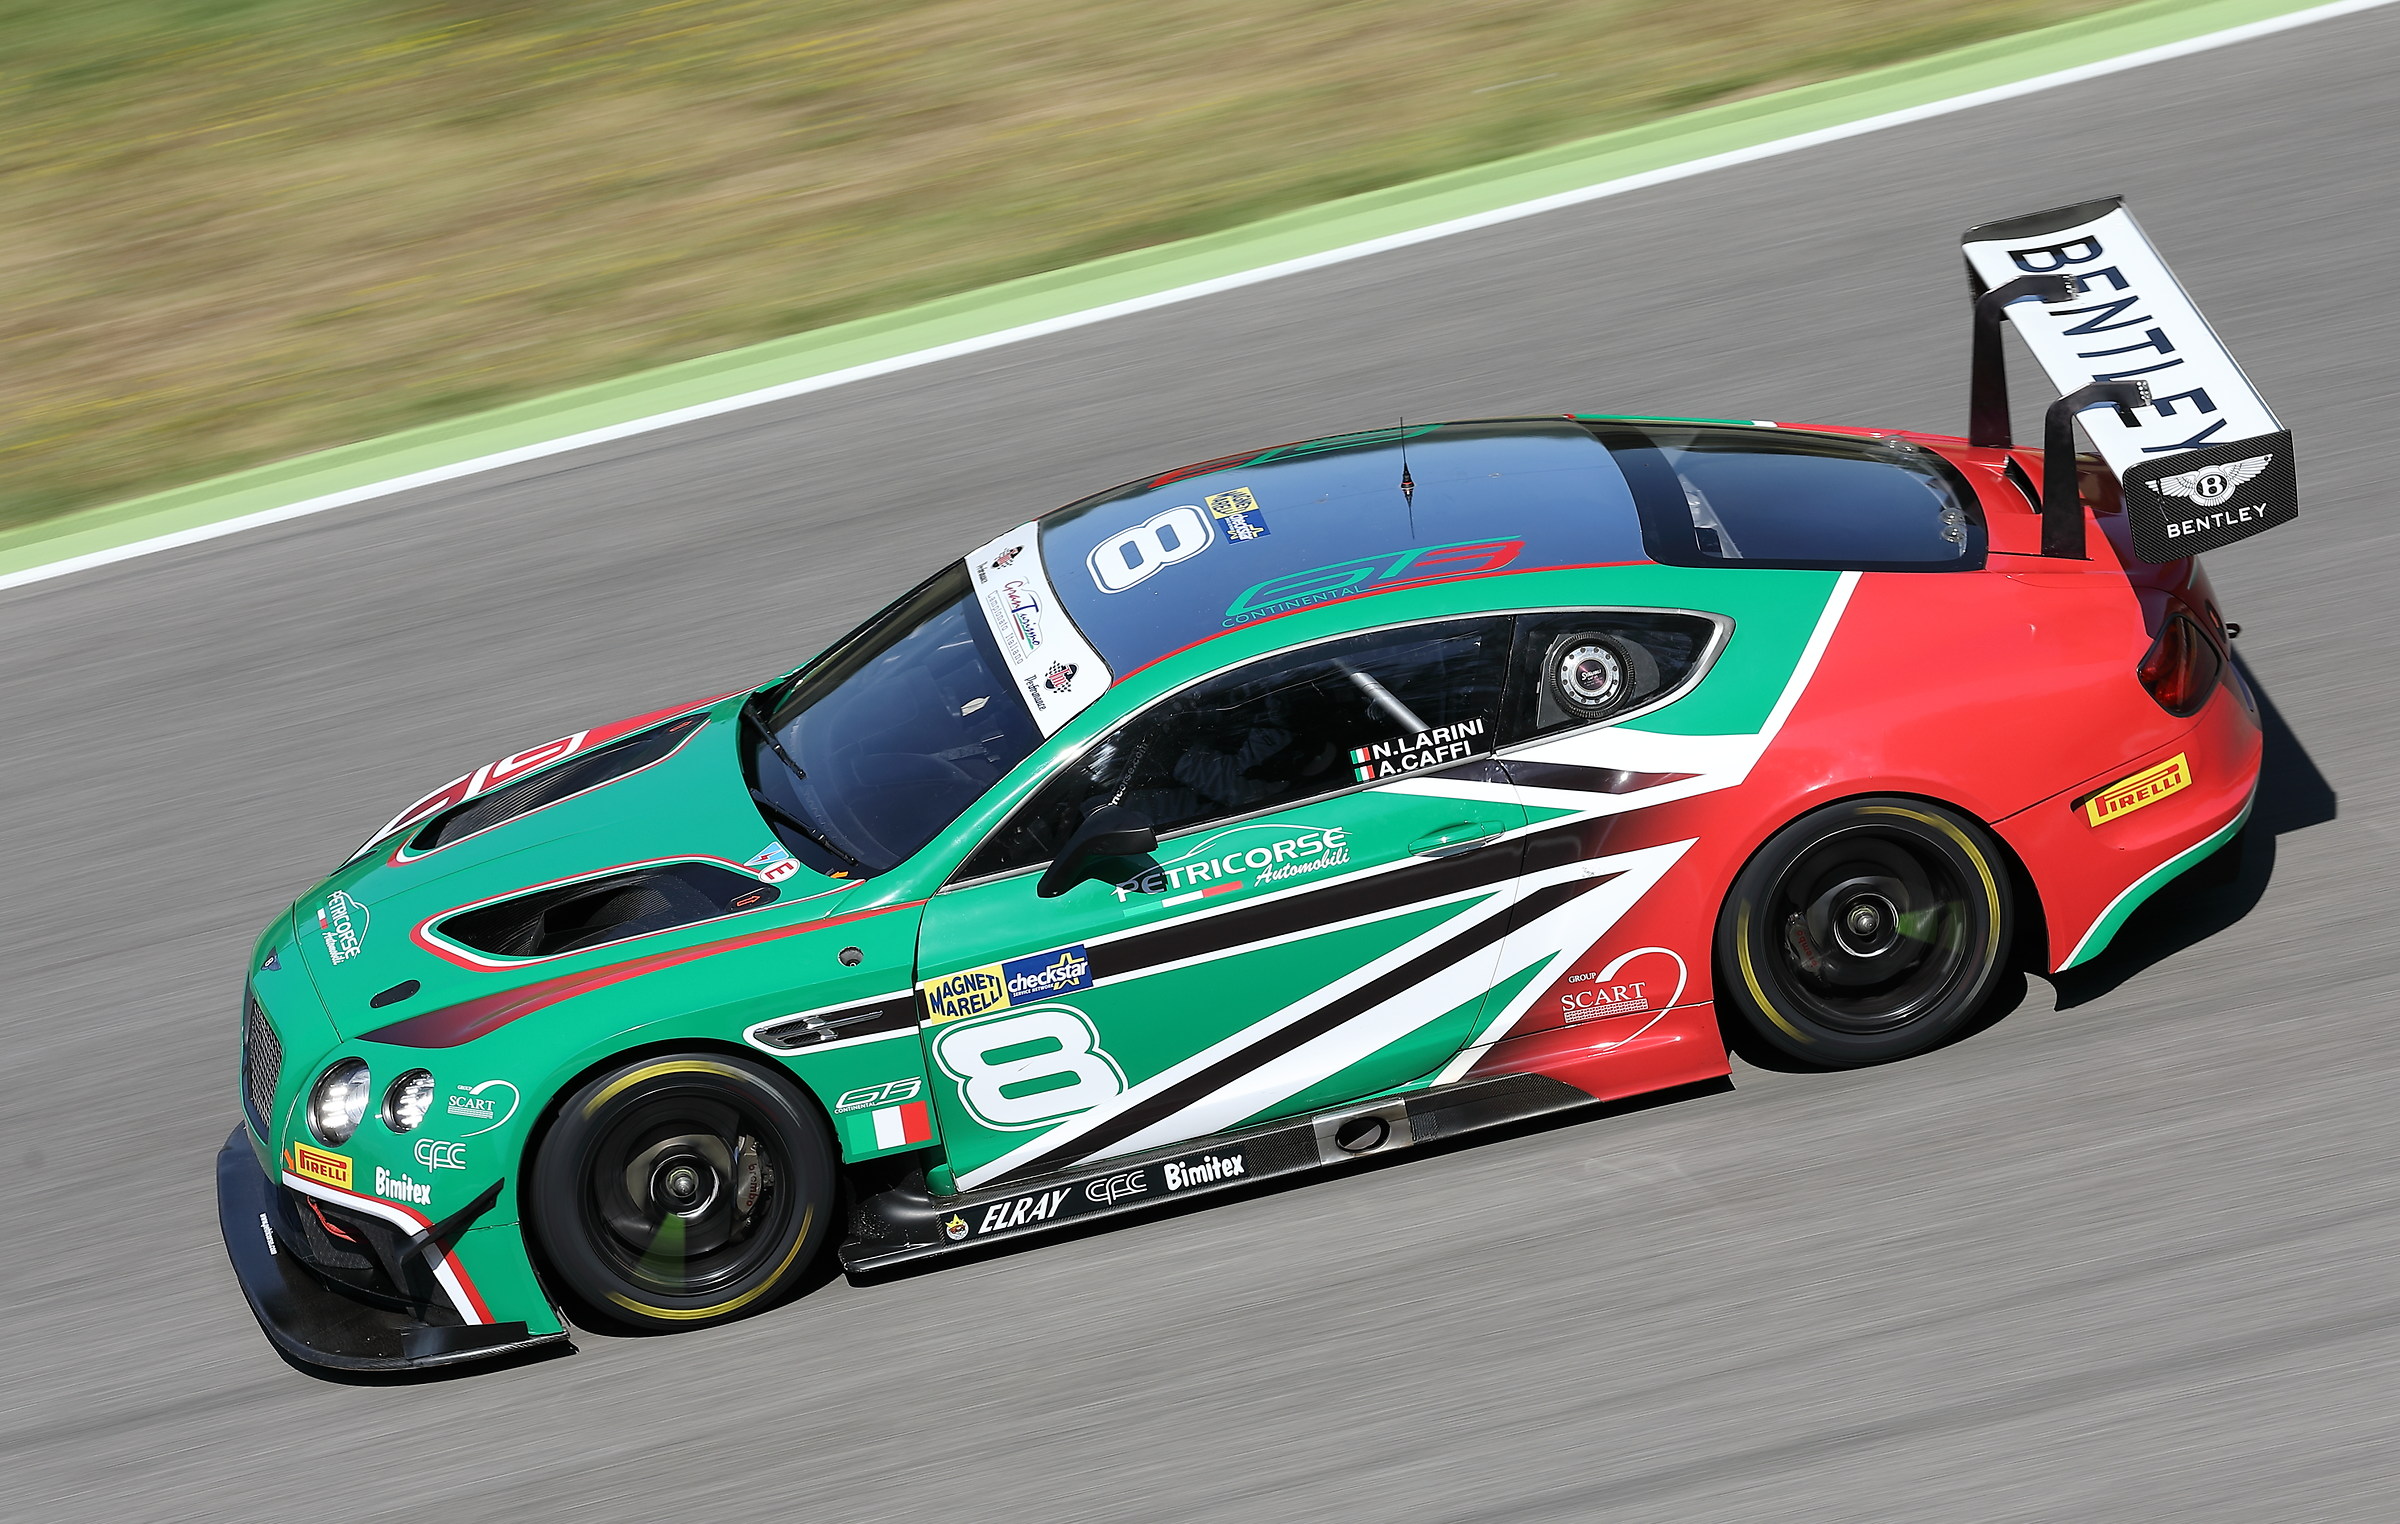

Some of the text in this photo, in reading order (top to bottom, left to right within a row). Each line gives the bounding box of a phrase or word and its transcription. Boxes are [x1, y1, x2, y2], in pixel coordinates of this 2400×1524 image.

[2166, 502, 2267, 539] BENTLEY
[1085, 505, 1216, 594] 8
[1221, 585, 1363, 629] CONTINENTAL
[987, 590, 1009, 632] Campionato
[1005, 632, 1024, 665] Italiano
[1371, 718, 1485, 760] N.LARINI
[1379, 740, 1472, 777] A.CAFFI
[2094, 763, 2182, 817] PIRELLI
[764, 862, 794, 880] E
[1114, 827, 1348, 902] PETRICORSE
[1253, 847, 1351, 887] Automobili
[327, 889, 361, 959] PETRICORSE
[929, 973, 1003, 1008] MAGNETI
[1007, 961, 1089, 992] checkstar
[1012, 983, 1055, 997] SERVICE NETWORK
[1568, 972, 1597, 984] GROUP
[929, 984, 1003, 1017] MARELLI
[1560, 981, 1646, 1012] SCART
[931, 1002, 1129, 1132] 8
[448, 1095, 496, 1111] SCART
[834, 1101, 877, 1115] CONTINENTAL
[299, 1149, 347, 1182] PIRELLI
[746, 1163, 759, 1206] brembo
[1162, 1152, 1247, 1191] Bimitex
[374, 1165, 432, 1206] Bimitex
[977, 1186, 1073, 1235] ELRAY
